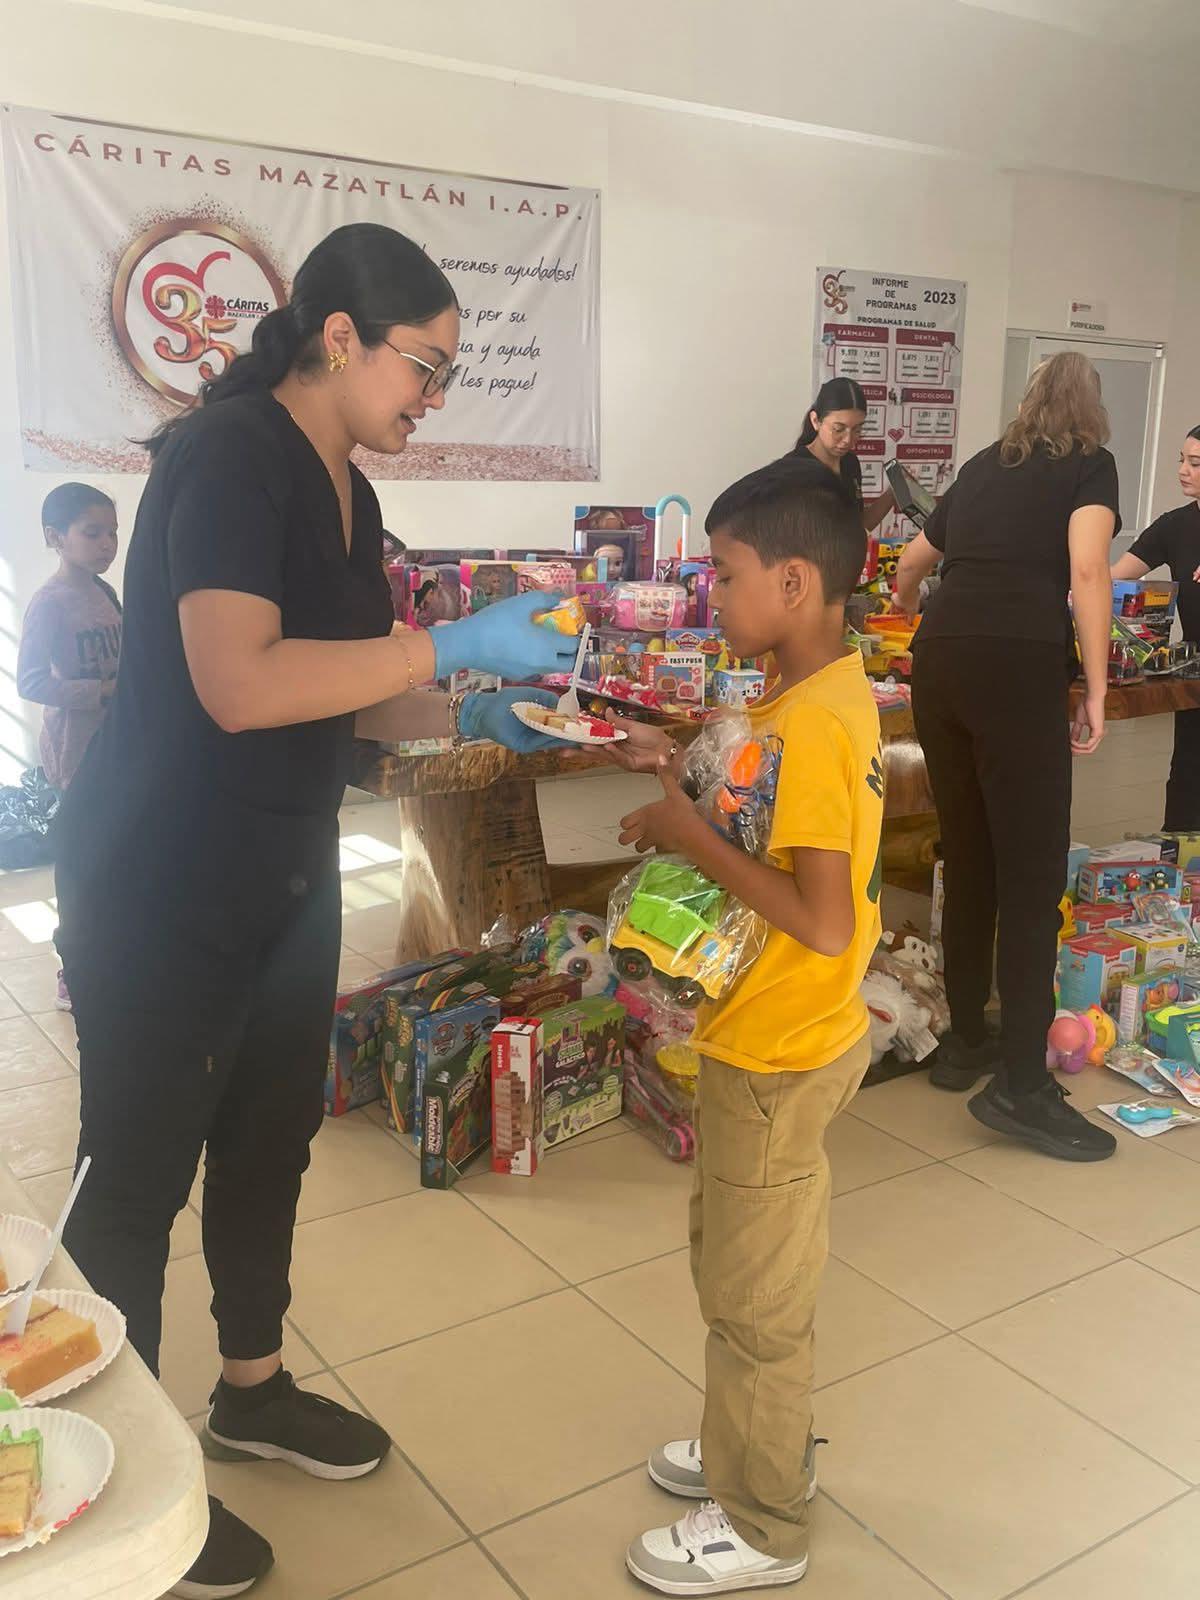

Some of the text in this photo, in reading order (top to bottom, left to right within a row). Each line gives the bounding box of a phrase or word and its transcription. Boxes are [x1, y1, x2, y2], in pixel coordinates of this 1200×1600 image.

[33, 133, 583, 220] CÁRITAS MAZATLÁN I.A.P.
[439, 256, 578, 286] seremos ayudados!
[871, 277, 909, 289] INFORME
[884, 290, 896, 299] DE
[923, 290, 957, 305] 2023
[226, 297, 270, 312] CÁRITAS
[865, 299, 918, 312] PROGRAMAS
[475, 309, 503, 328] por
[508, 311, 528, 323] su
[856, 316, 937, 329] PROGRAMAS DE SALUD
[480, 343, 491, 364] y
[497, 336, 541, 365] ayuda
[460, 367, 538, 398] les pague!
